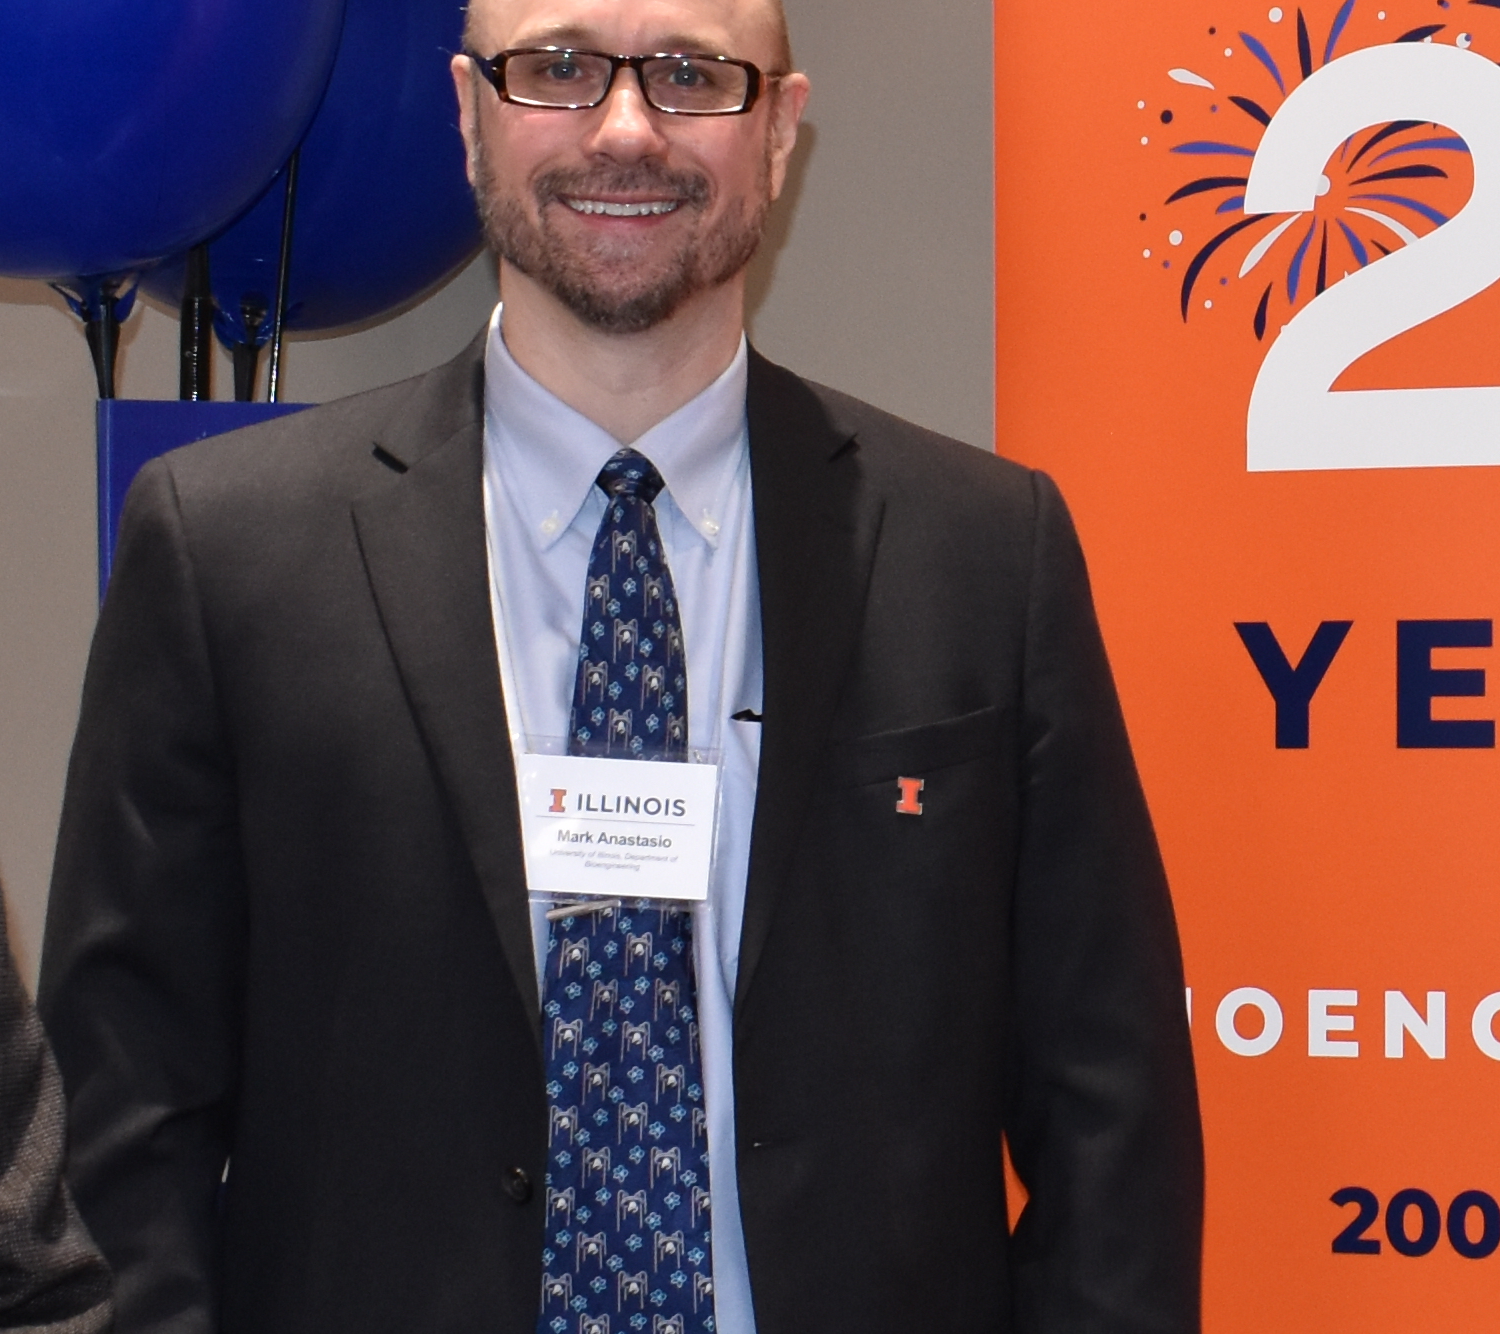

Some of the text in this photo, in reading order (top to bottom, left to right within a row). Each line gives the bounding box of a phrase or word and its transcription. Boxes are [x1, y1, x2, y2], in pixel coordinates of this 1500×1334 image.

[577, 793, 686, 817] ILLINOIS
[557, 829, 672, 848] Mark Anastasio
